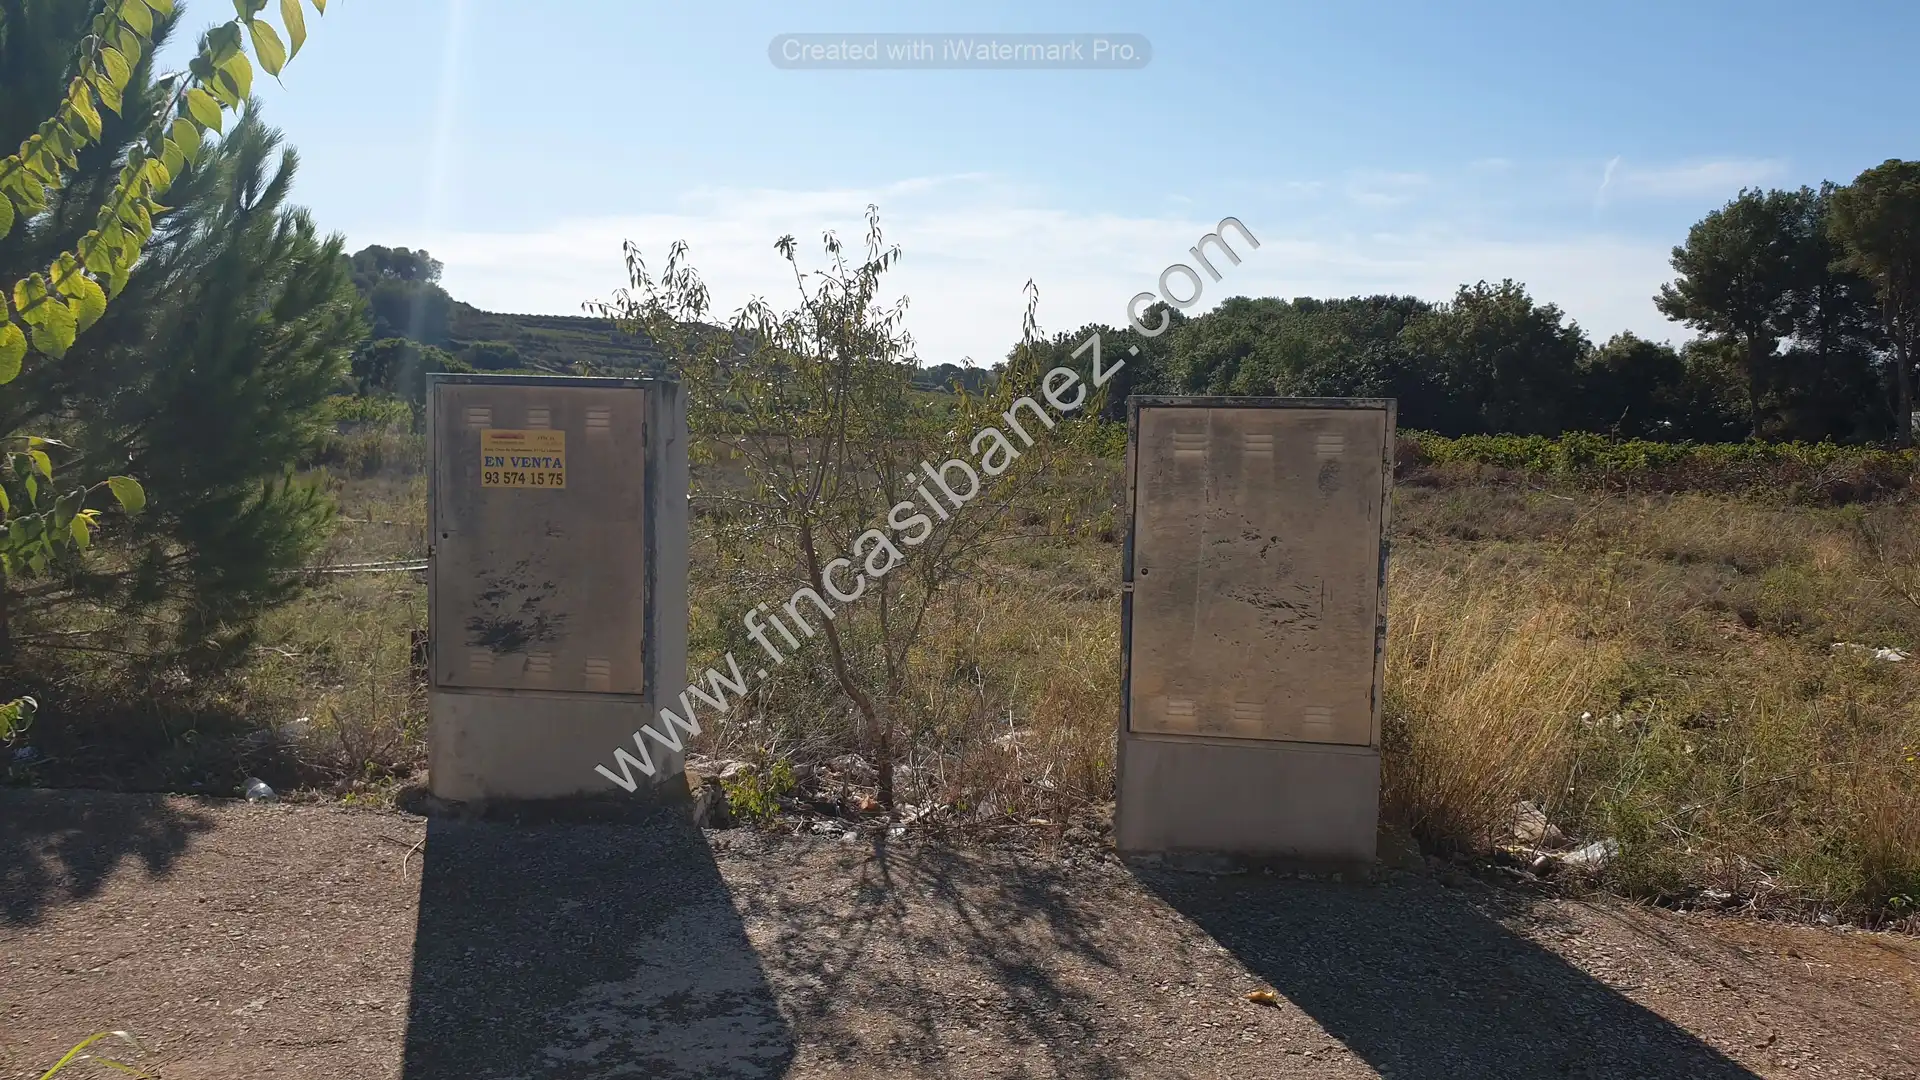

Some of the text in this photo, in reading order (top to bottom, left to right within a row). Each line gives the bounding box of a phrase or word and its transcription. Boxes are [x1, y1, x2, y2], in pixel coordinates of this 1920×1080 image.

[484, 456, 563, 469] EN VENTA
[484, 471, 563, 486] 93 574 15 75
